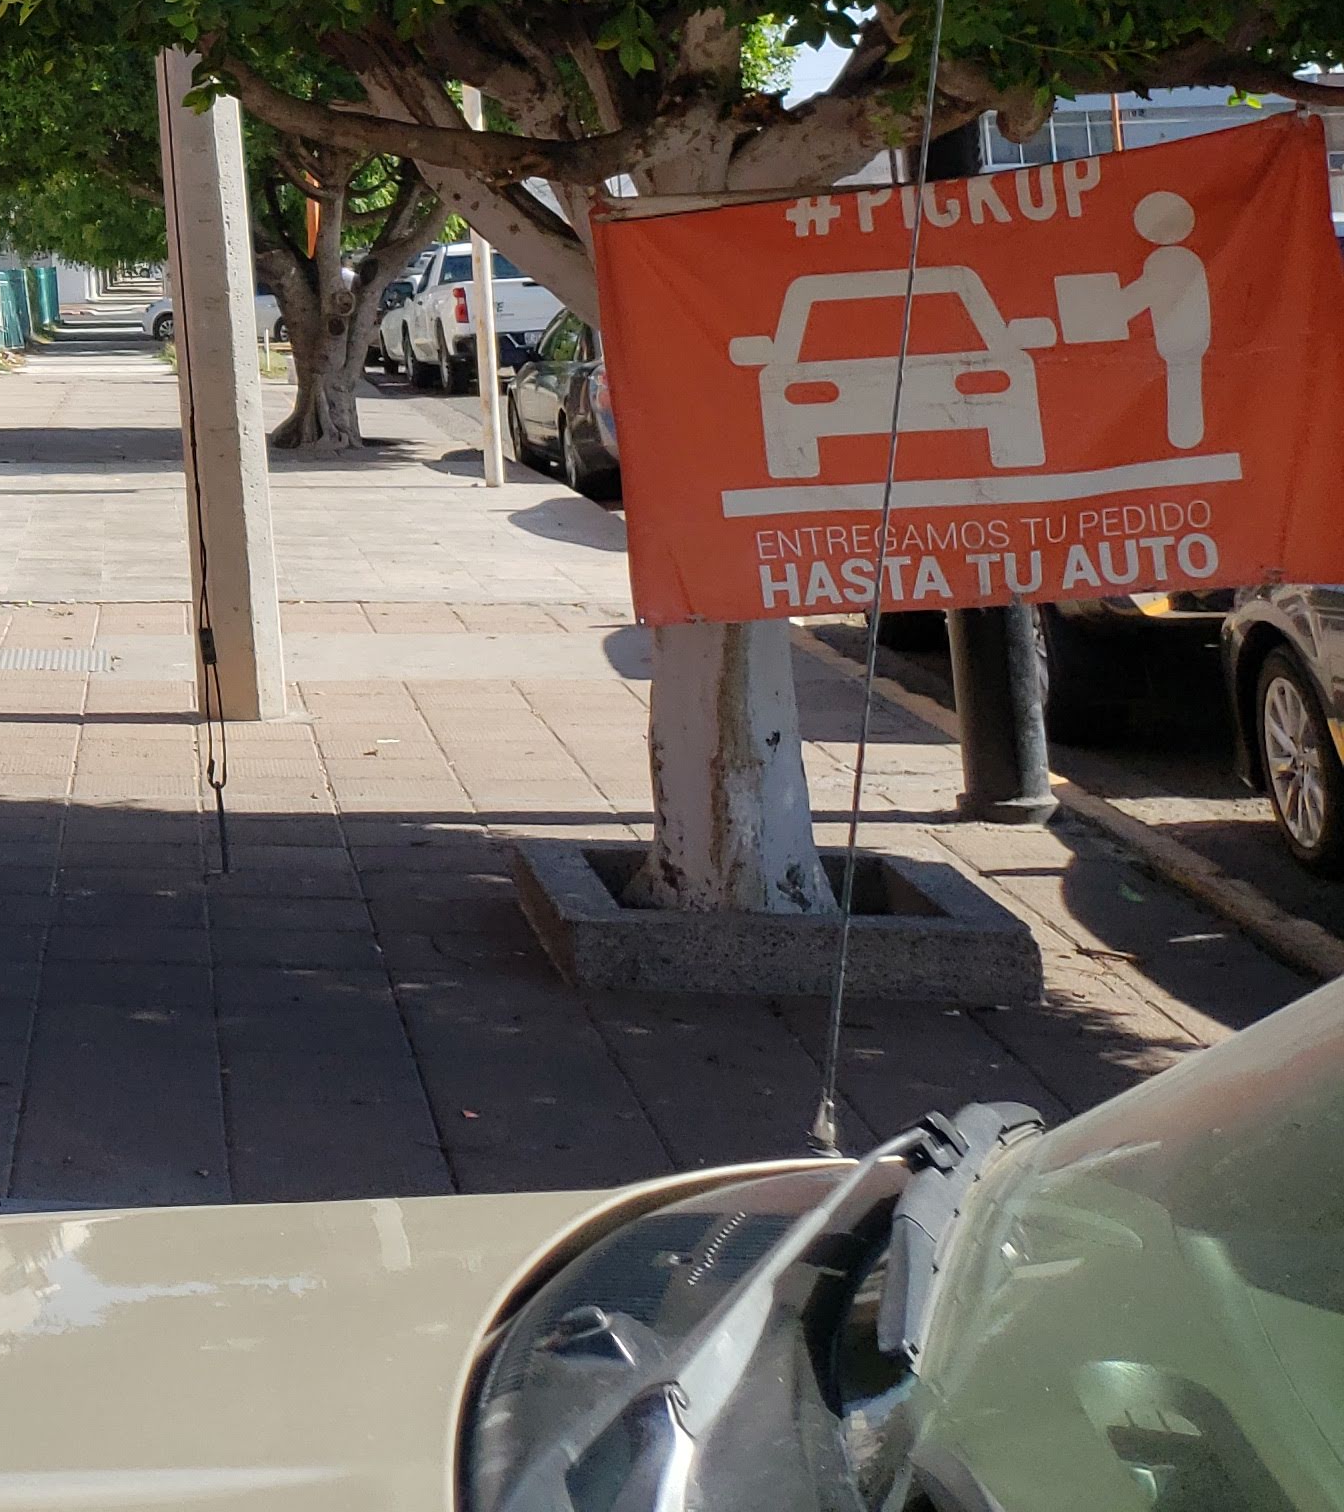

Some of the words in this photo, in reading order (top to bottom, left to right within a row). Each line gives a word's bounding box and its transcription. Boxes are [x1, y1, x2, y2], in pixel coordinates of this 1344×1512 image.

[786, 157, 1101, 237] #PICKUP
[757, 519, 1010, 560] ENTREGAMOS
[1020, 514, 1067, 545] TU
[1079, 500, 1211, 539] PEDIDO
[759, 555, 953, 609] HASTA
[965, 550, 1043, 596] TU
[1062, 532, 1220, 588] AUTO
